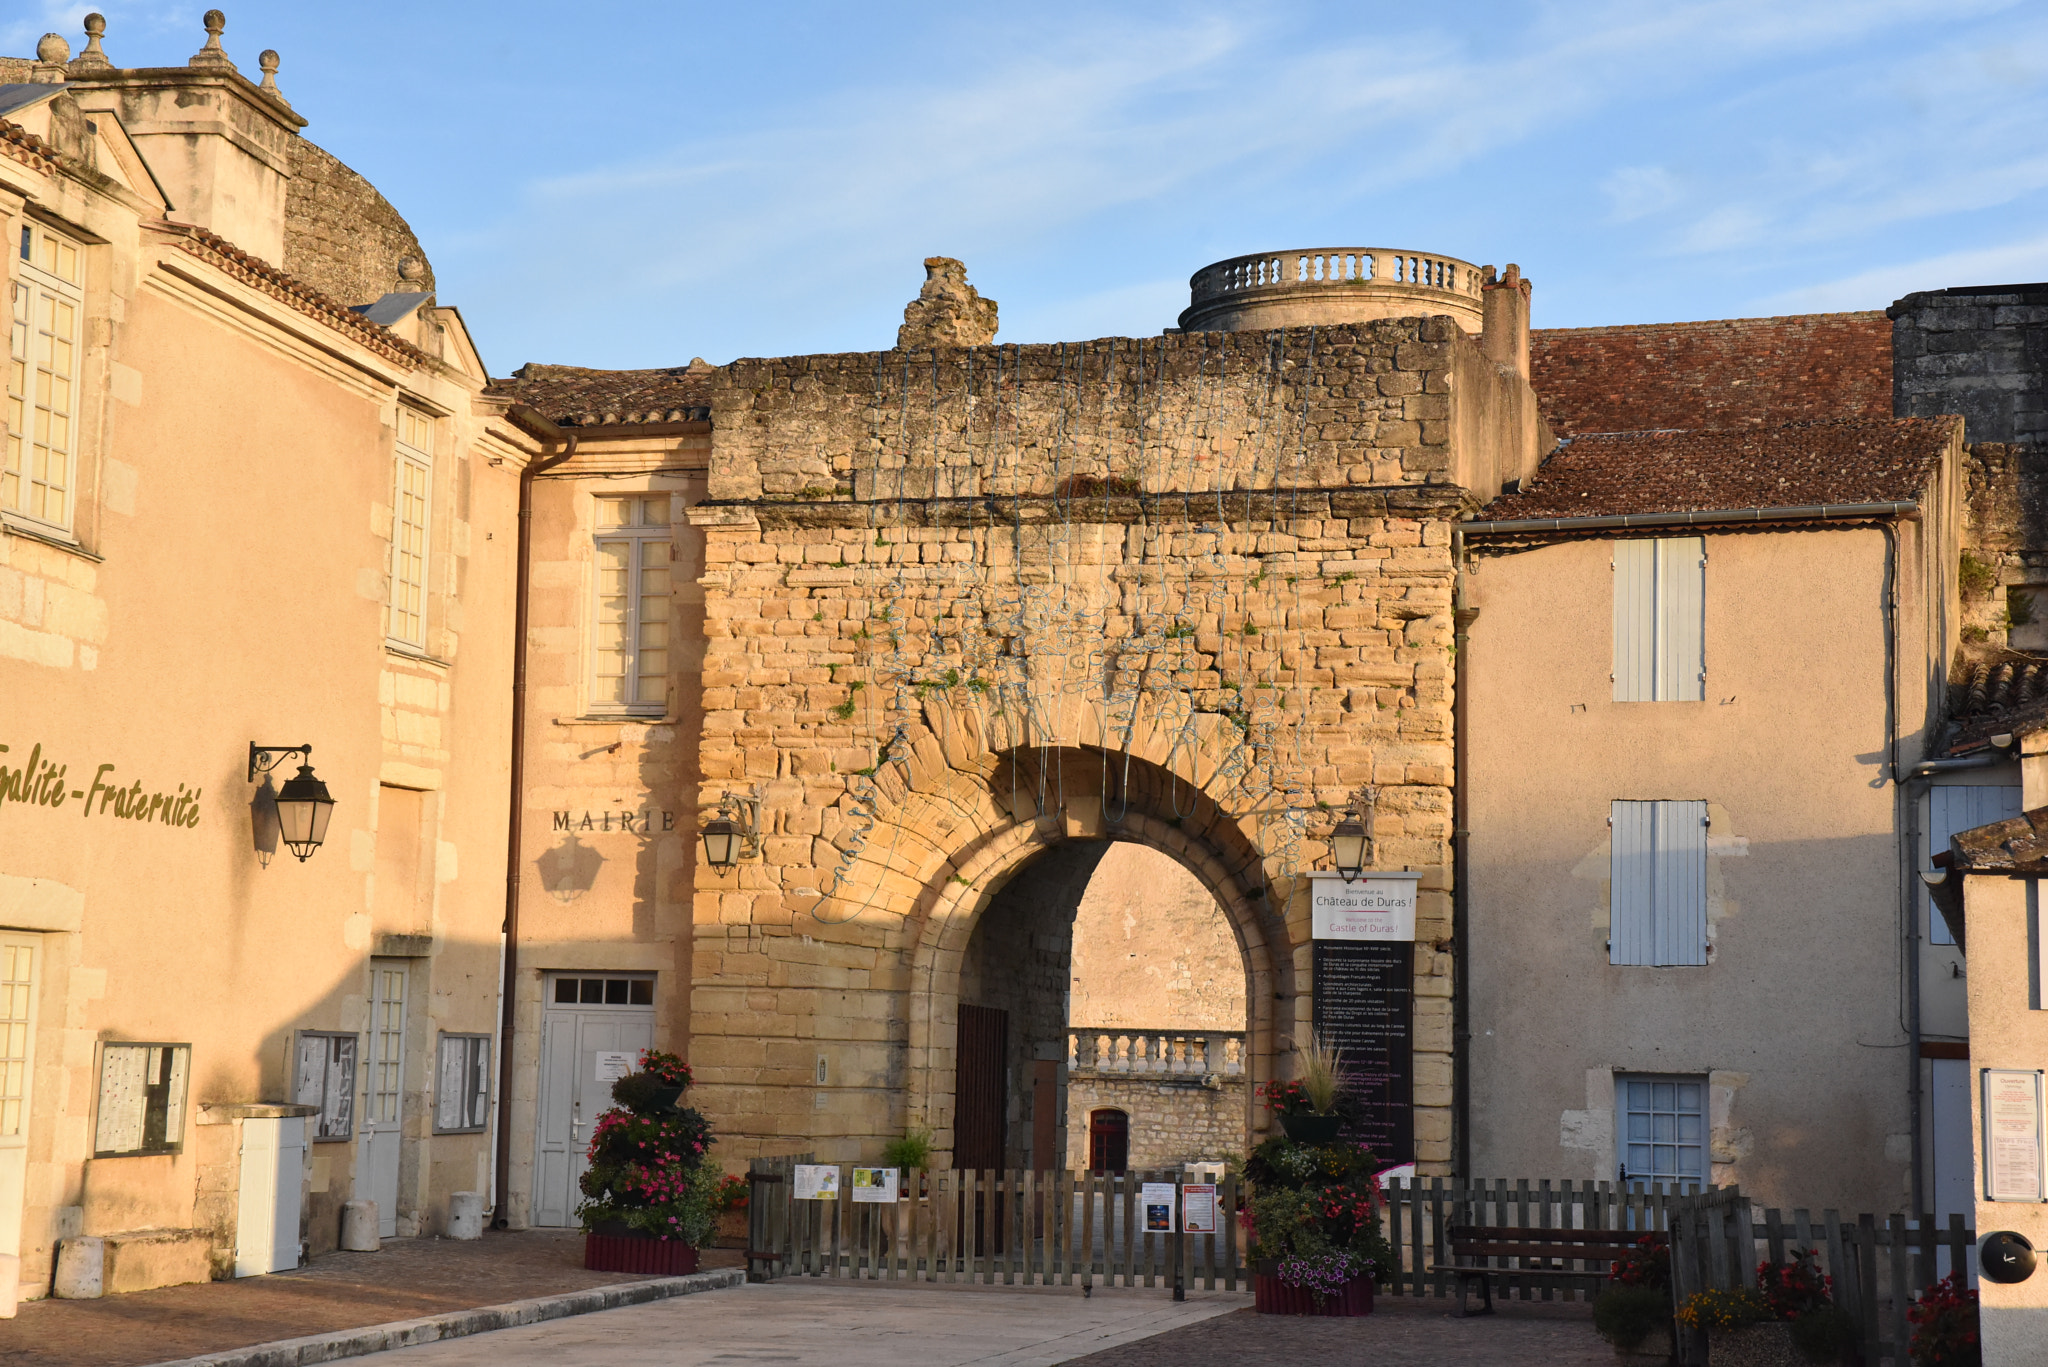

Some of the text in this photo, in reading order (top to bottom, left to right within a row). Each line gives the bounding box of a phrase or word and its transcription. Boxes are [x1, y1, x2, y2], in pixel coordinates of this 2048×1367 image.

[0, 743, 67, 808] galité
[84, 764, 202, 828] Fraternité
[552, 810, 674, 831] MAIRIE
[1316, 896, 1358, 906] Château
[1361, 897, 1374, 906] de
[1377, 898, 1406, 907] Duras
[1329, 923, 1357, 932] Castle
[1359, 924, 1368, 932] of
